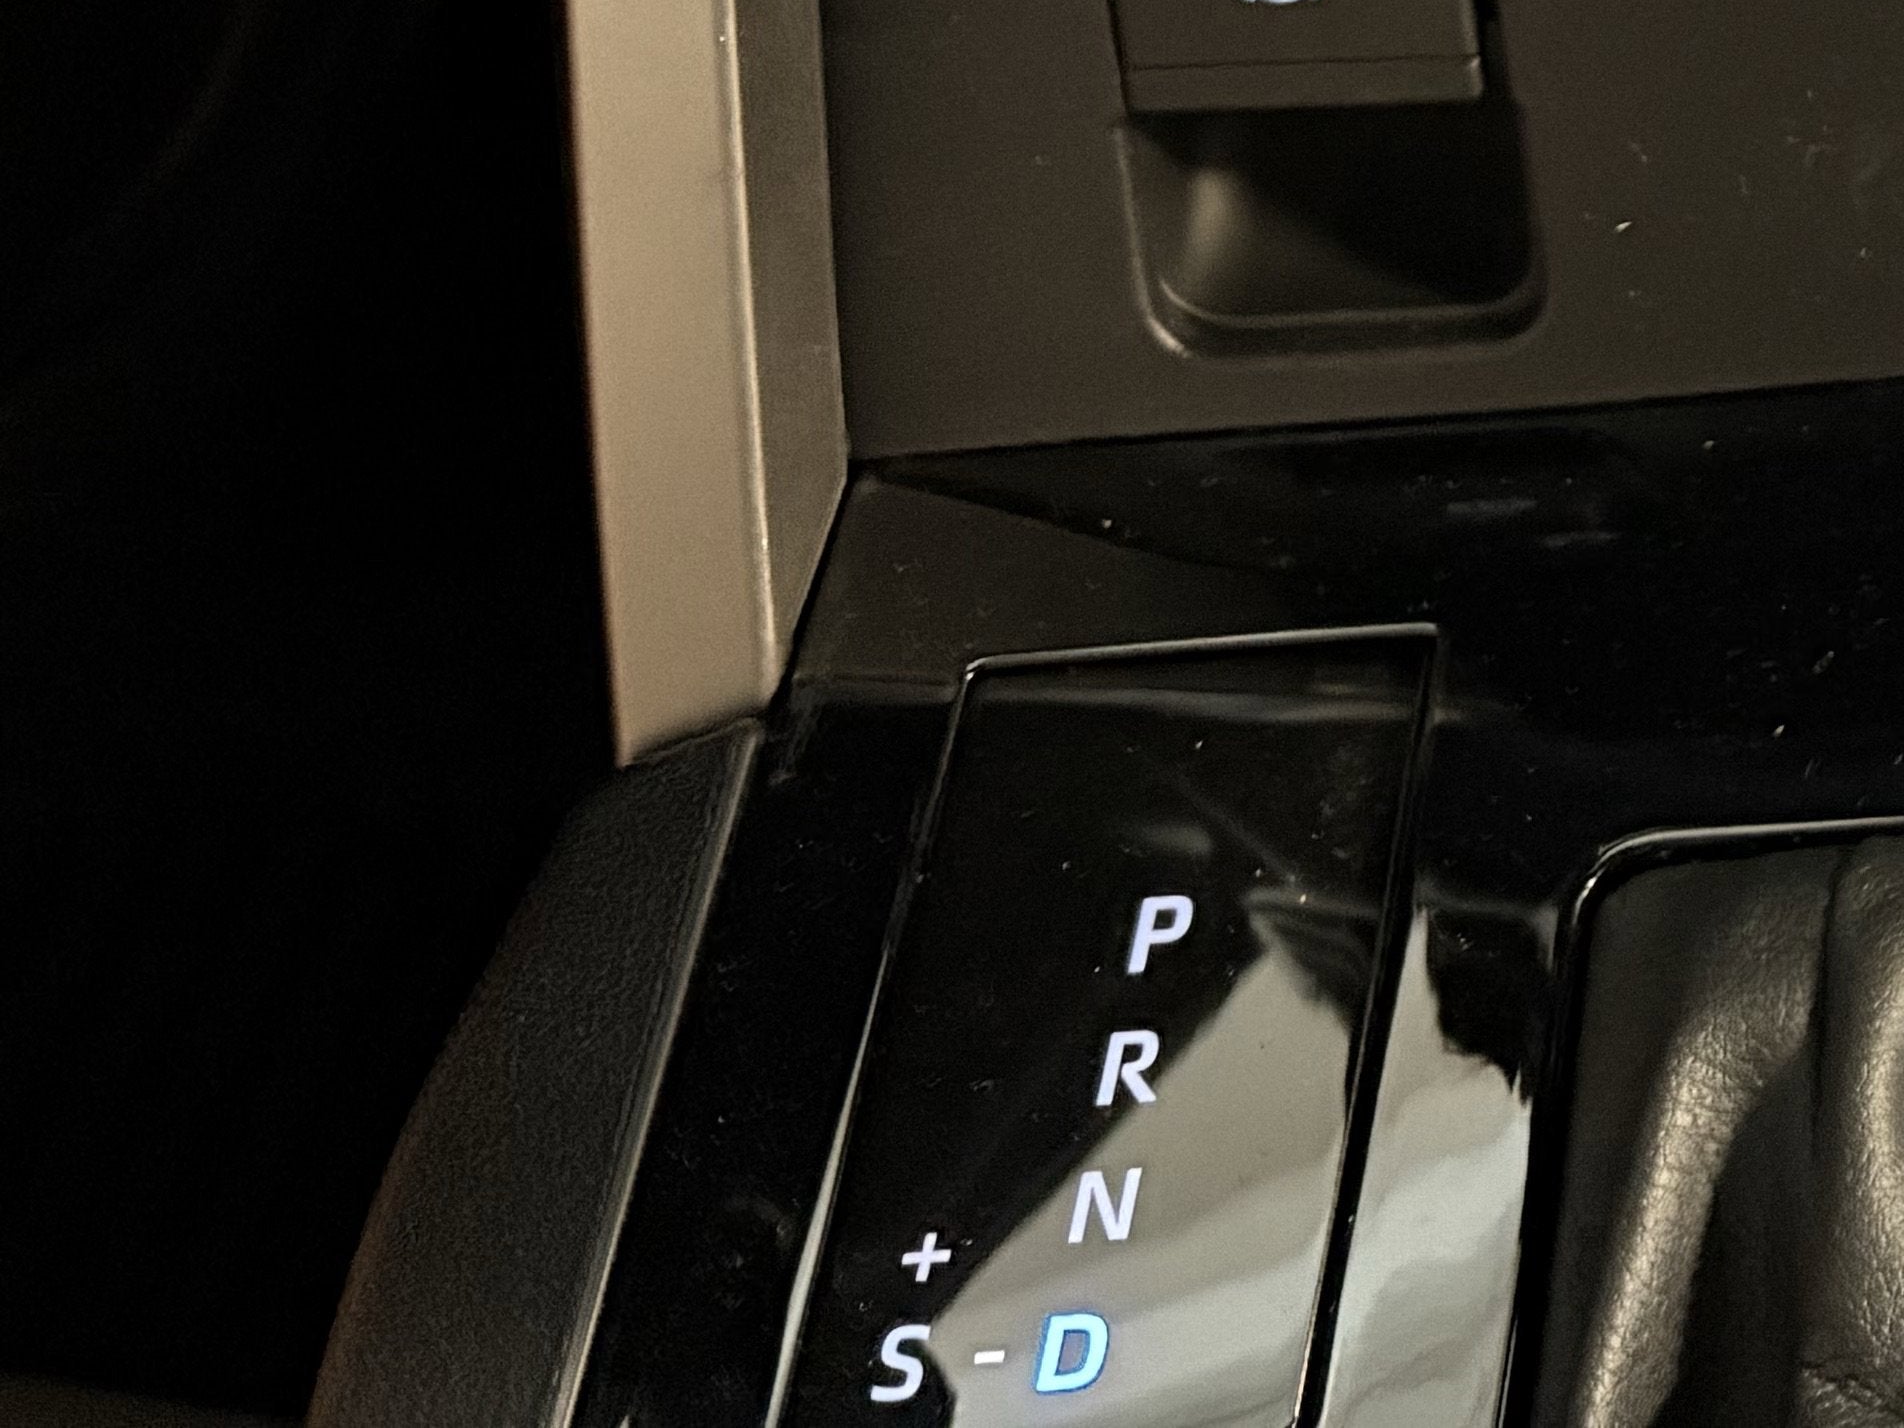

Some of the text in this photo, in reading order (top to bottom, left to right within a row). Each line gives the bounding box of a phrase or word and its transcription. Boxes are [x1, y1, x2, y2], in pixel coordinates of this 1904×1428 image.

[1126, 894, 1195, 975] P
[1094, 1029, 1162, 1107] R
[1066, 1165, 1144, 1245] N
[869, 1323, 933, 1404] S
[1033, 1311, 1111, 1394] D
